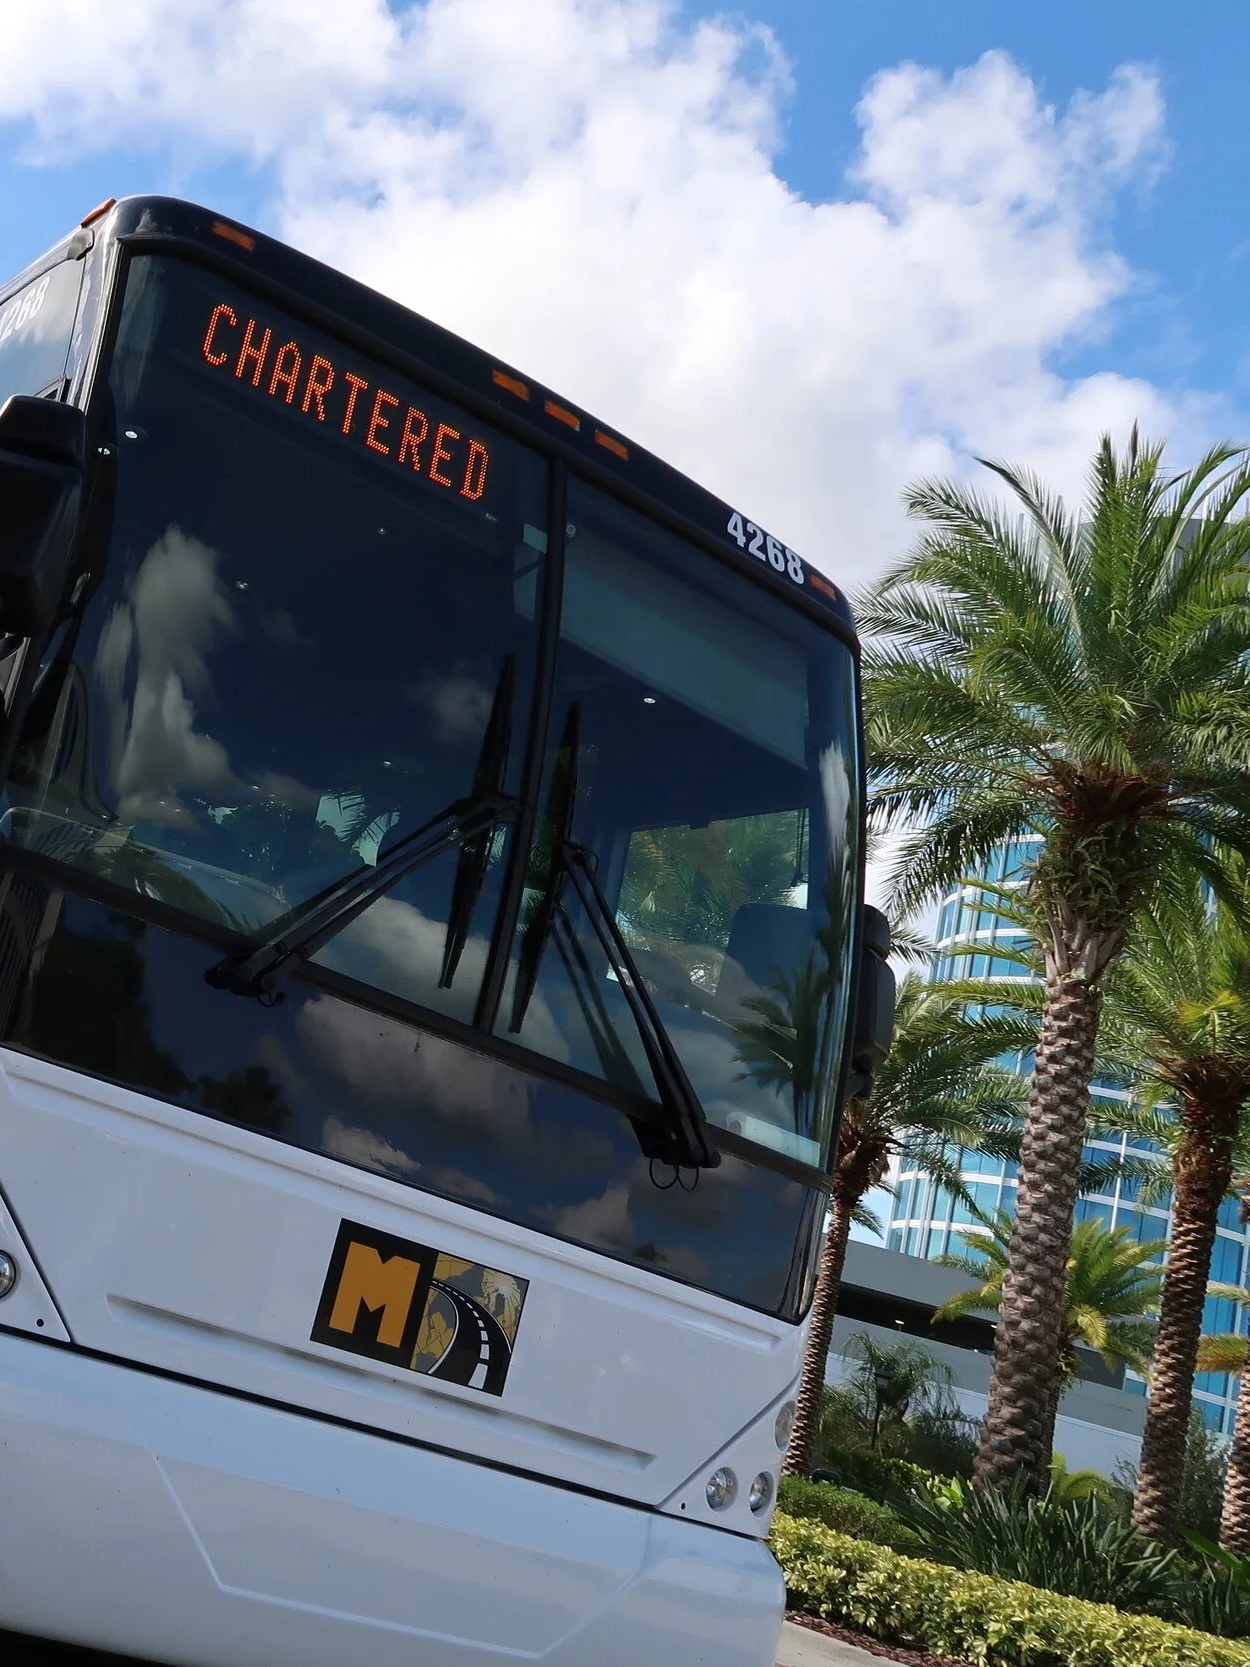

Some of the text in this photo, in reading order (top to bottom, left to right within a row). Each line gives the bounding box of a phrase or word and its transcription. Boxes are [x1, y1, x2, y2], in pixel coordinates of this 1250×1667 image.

[202, 303, 490, 501] CHARTERED
[726, 511, 805, 585] 4268
[328, 1240, 421, 1348] M
